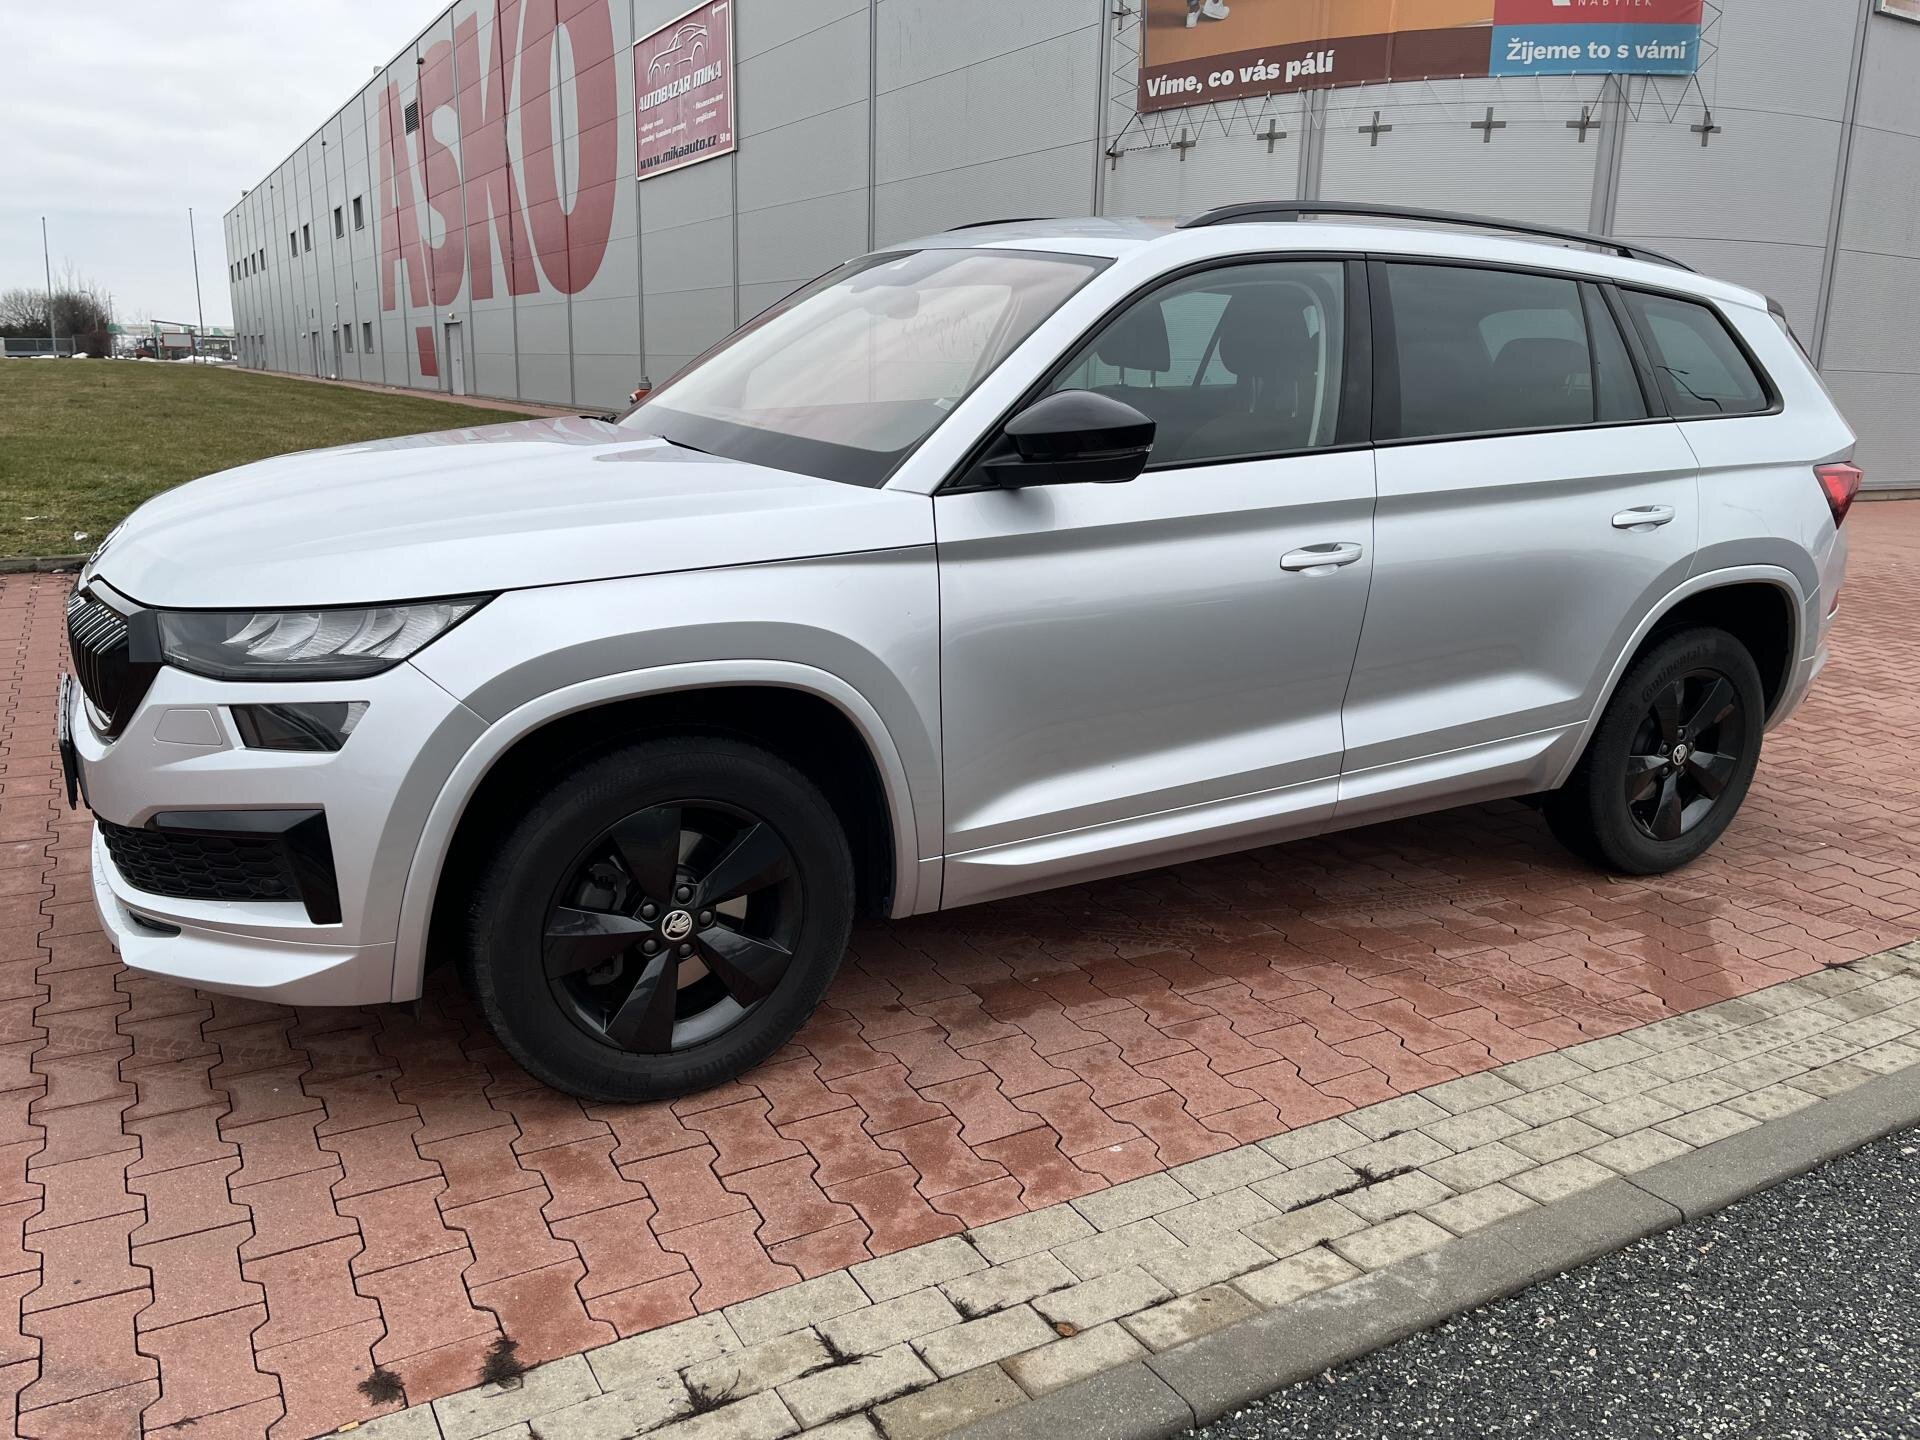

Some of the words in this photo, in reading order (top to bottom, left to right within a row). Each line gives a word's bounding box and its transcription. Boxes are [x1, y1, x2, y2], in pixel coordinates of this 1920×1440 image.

[1146, 74, 1203, 97] Víme,
[1208, 69, 1235, 88] co
[1239, 58, 1280, 84] vás
[1285, 49, 1336, 83] pálí
[1506, 37, 1581, 65] Žijeme
[1587, 41, 1608, 60] to
[1616, 44, 1629, 59] s
[1634, 40, 1686, 60] vámi
[639, 75, 691, 112] AUTOBAZAR
[693, 60, 722, 89] MIKA
[378, 0, 618, 311] ASKO
[640, 134, 717, 169] www.mikaauto.cz
